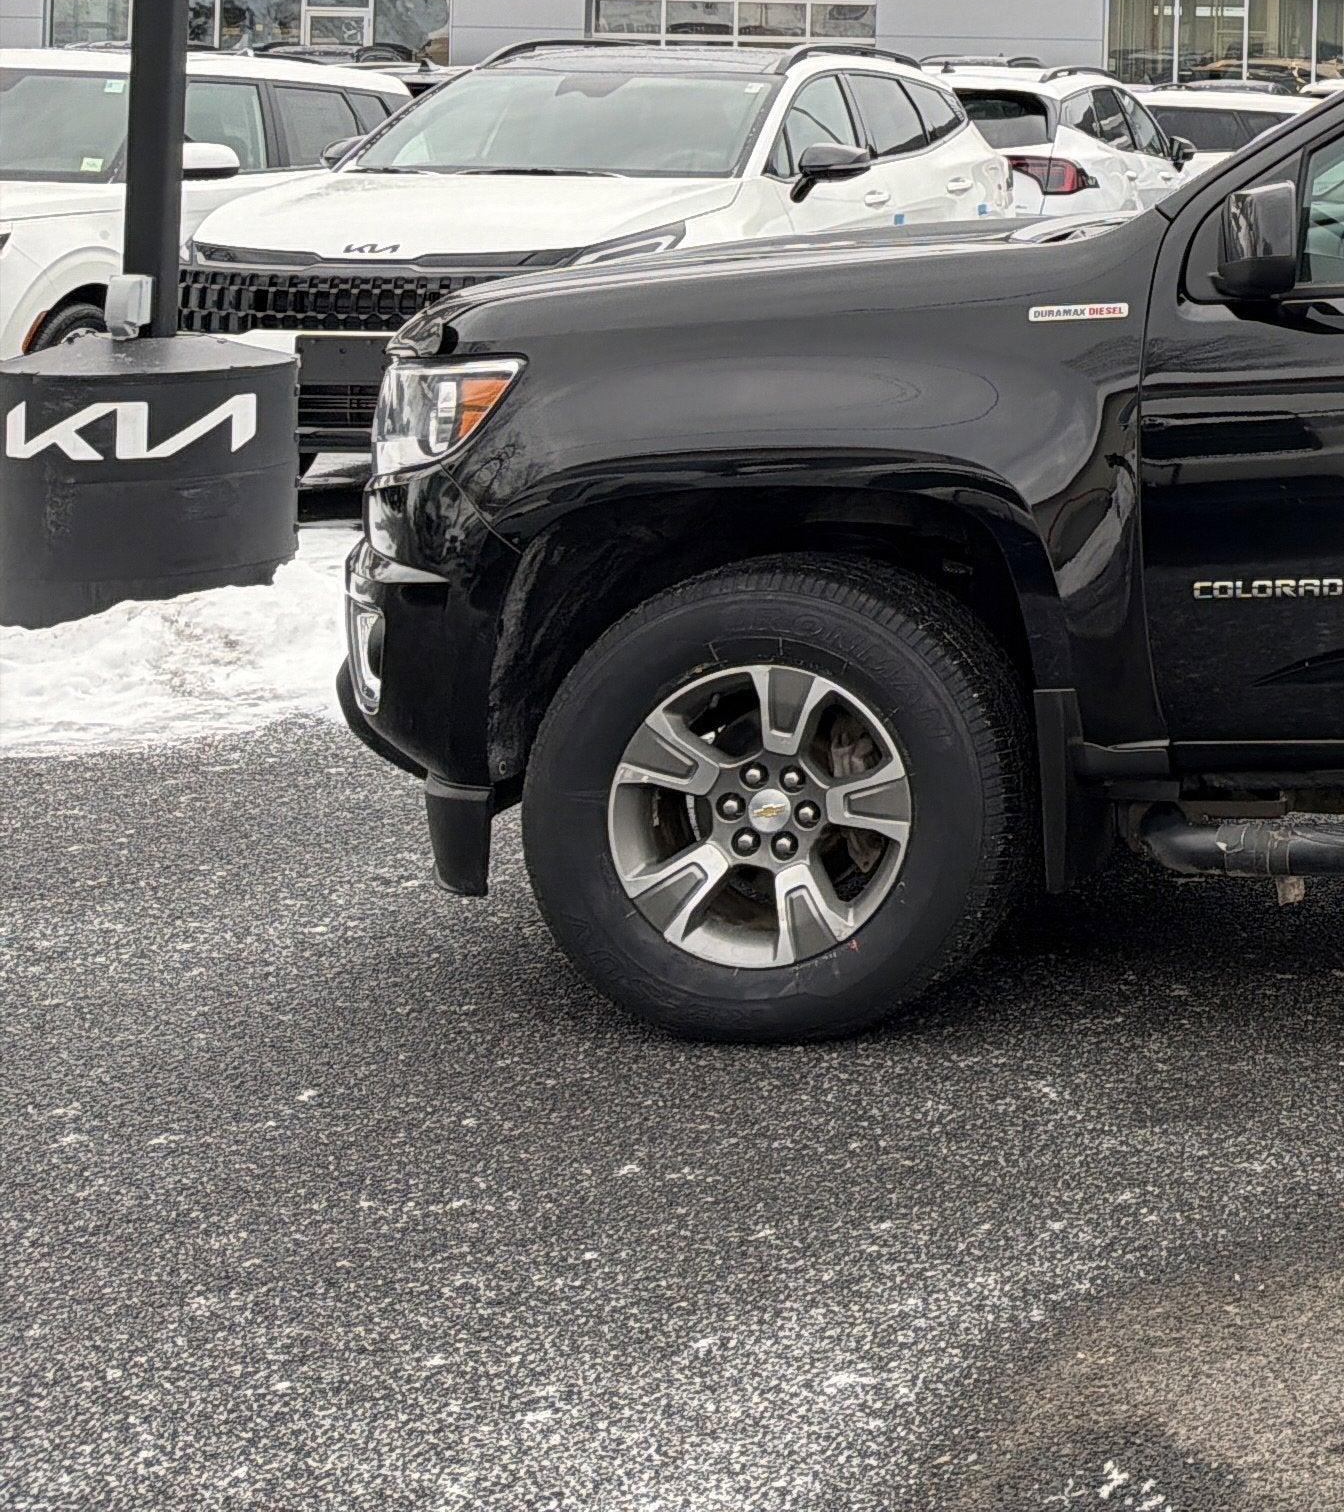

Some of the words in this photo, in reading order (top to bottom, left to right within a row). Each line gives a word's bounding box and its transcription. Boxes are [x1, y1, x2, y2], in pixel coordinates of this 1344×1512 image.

[1033, 308, 1086, 318] DURAMAX
[1088, 306, 1124, 316] DIESEL
[6, 393, 257, 461] KIA
